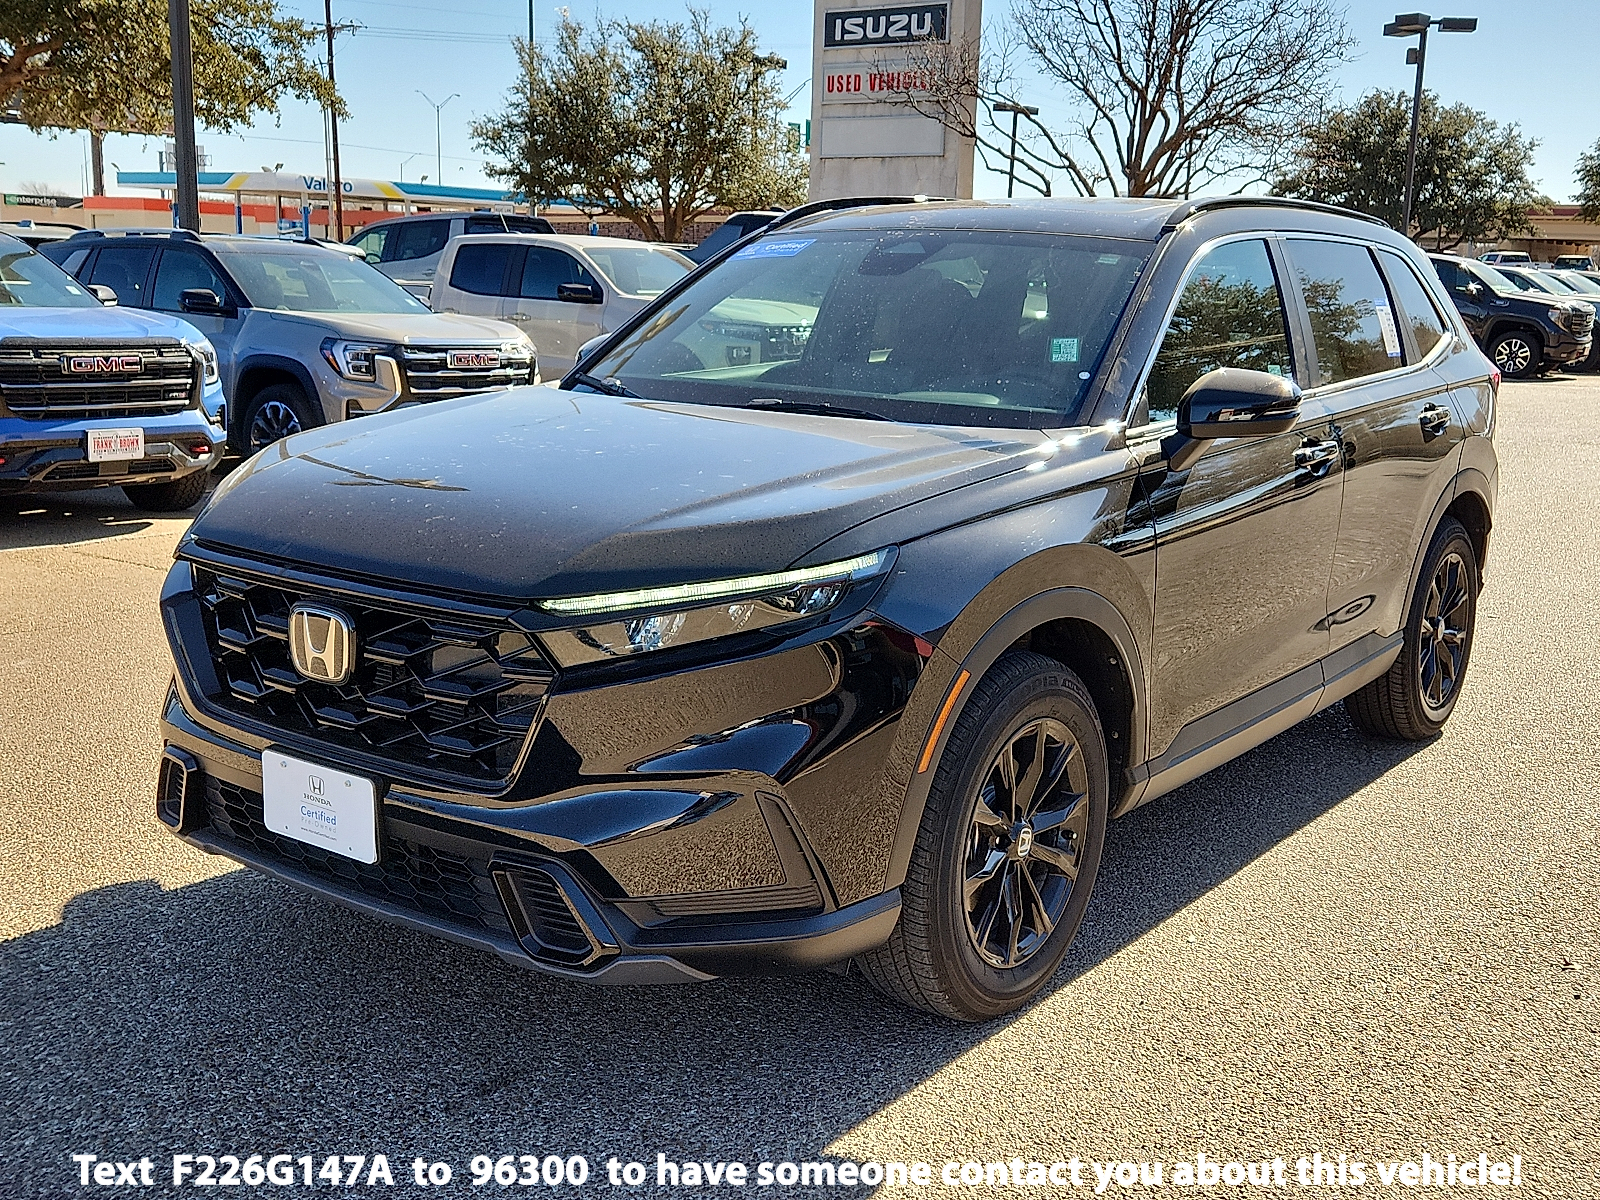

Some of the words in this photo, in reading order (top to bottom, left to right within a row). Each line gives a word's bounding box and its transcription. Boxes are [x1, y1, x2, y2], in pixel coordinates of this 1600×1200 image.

[834, 12, 932, 41] ISUZU
[826, 74, 861, 93] USED
[70, 356, 141, 373] GMC
[454, 353, 500, 367] GMC
[303, 792, 332, 807] HONDA
[300, 805, 337, 826] Certified
